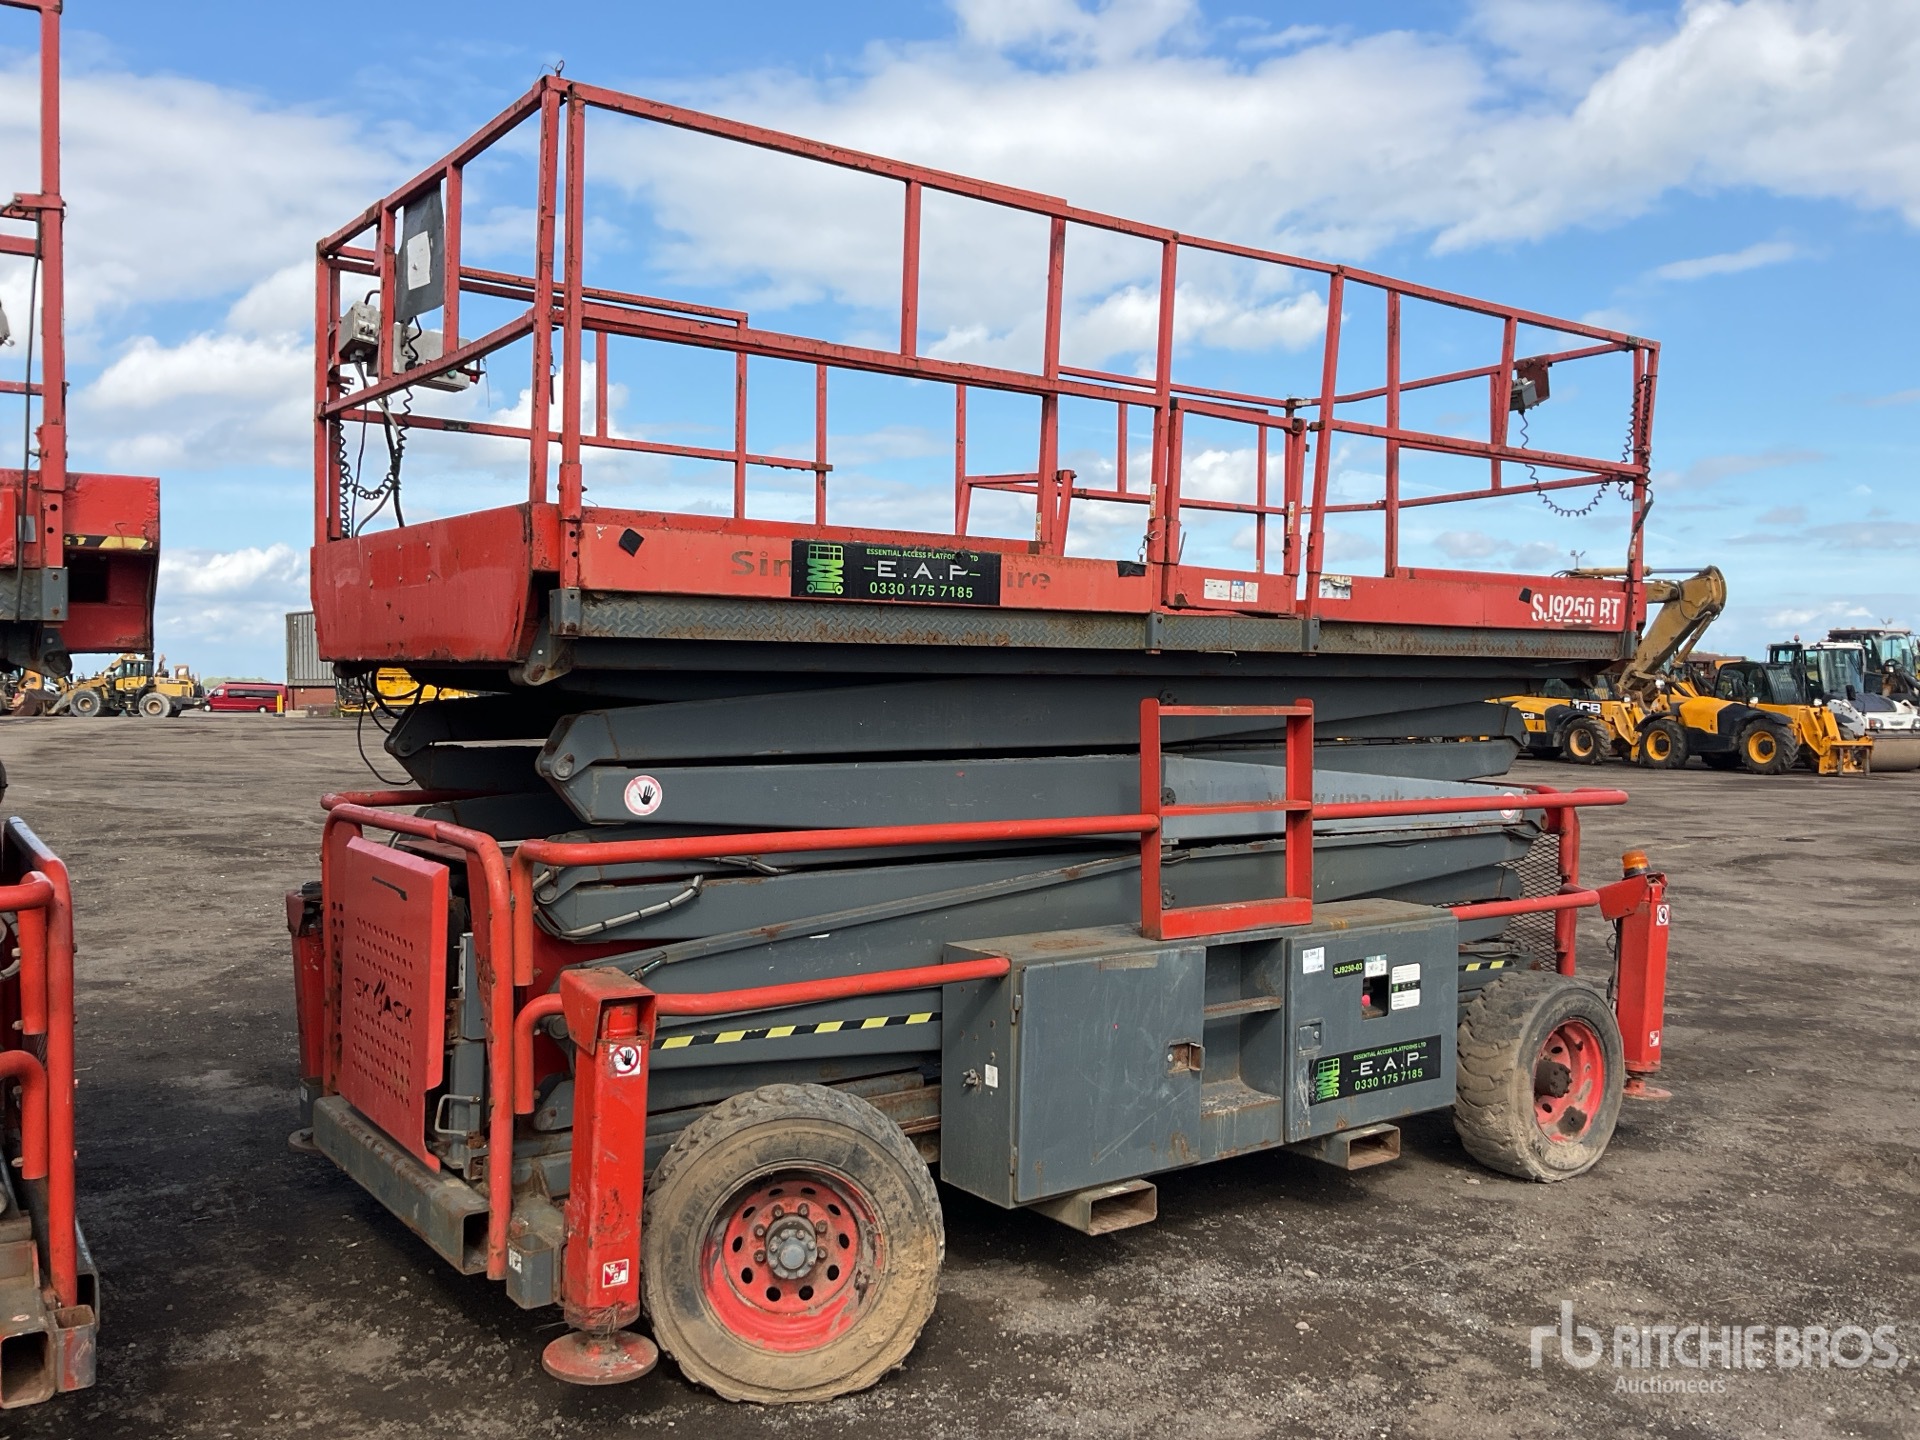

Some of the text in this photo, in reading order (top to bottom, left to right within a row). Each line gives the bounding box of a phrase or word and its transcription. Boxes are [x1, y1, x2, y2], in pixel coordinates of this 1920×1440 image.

[866, 548, 901, 557] ESSENTIAL
[902, 550, 926, 559] ACCESS
[869, 581, 973, 599] 0330 175 7185
[1531, 593, 1621, 625] SJ9250 RT
[1353, 1051, 1376, 1061] ESSENTIAL
[1377, 1048, 1393, 1056] ACCESS
[1354, 1068, 1423, 1091] 0330 175 7185
